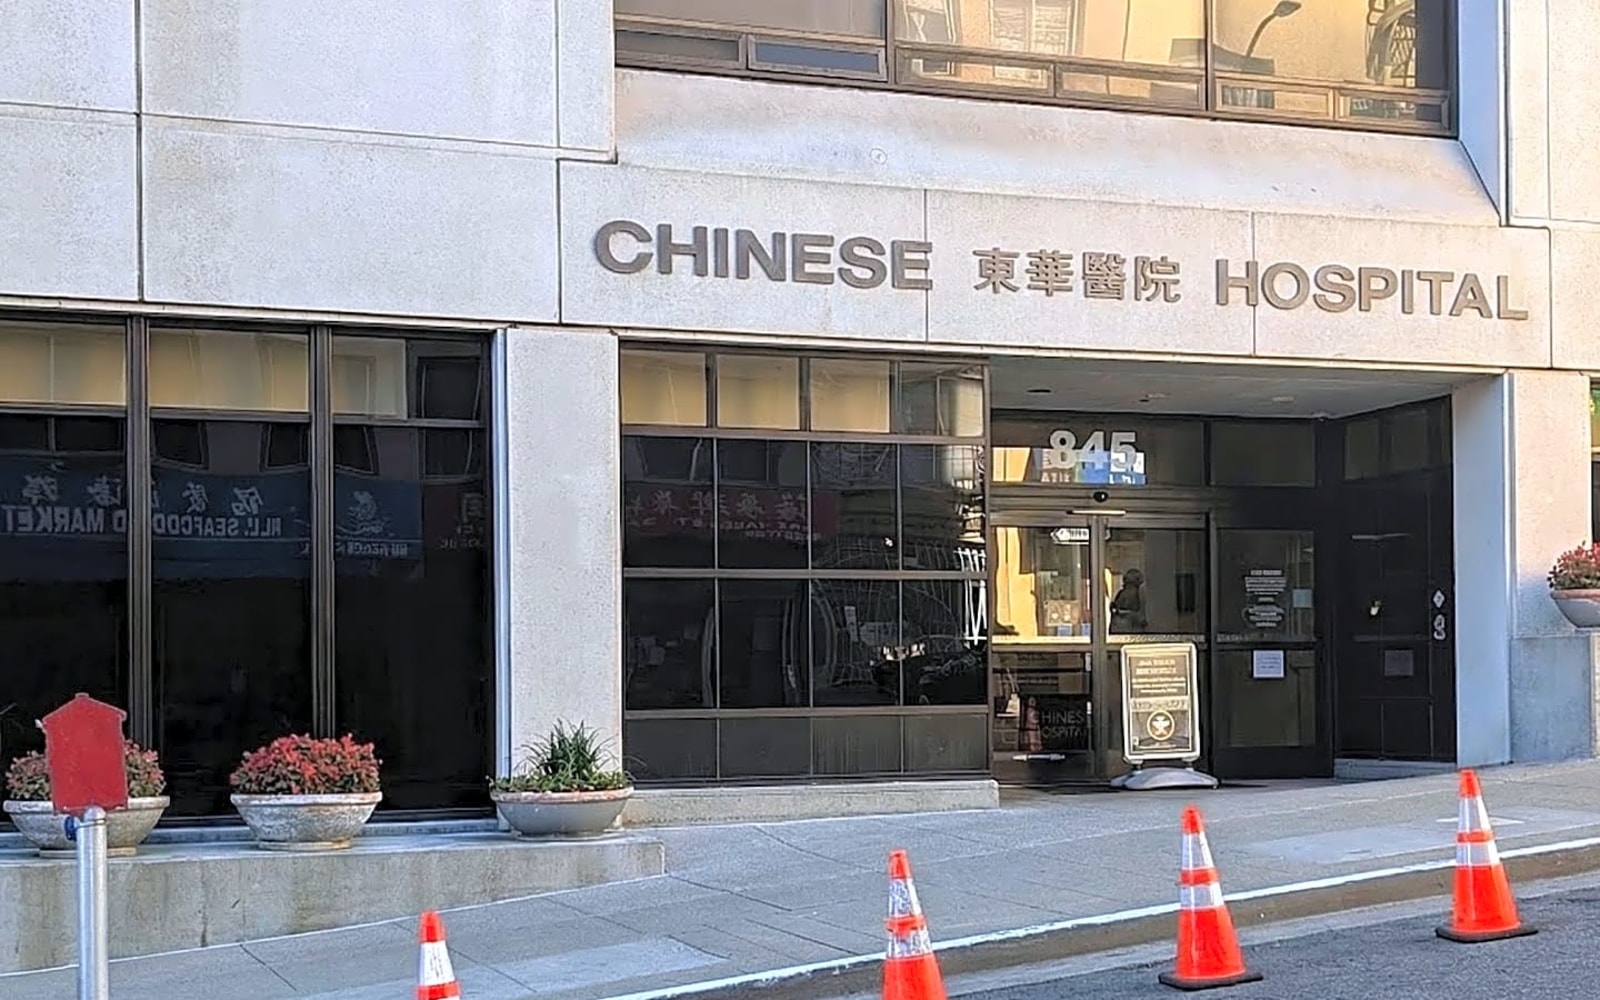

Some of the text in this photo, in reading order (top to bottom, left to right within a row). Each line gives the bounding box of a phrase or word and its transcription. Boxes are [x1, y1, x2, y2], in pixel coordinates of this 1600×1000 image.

[595, 219, 1528, 321] CHINESE 東華醫院 HOSPITAL
[1049, 429, 1138, 470] 845
